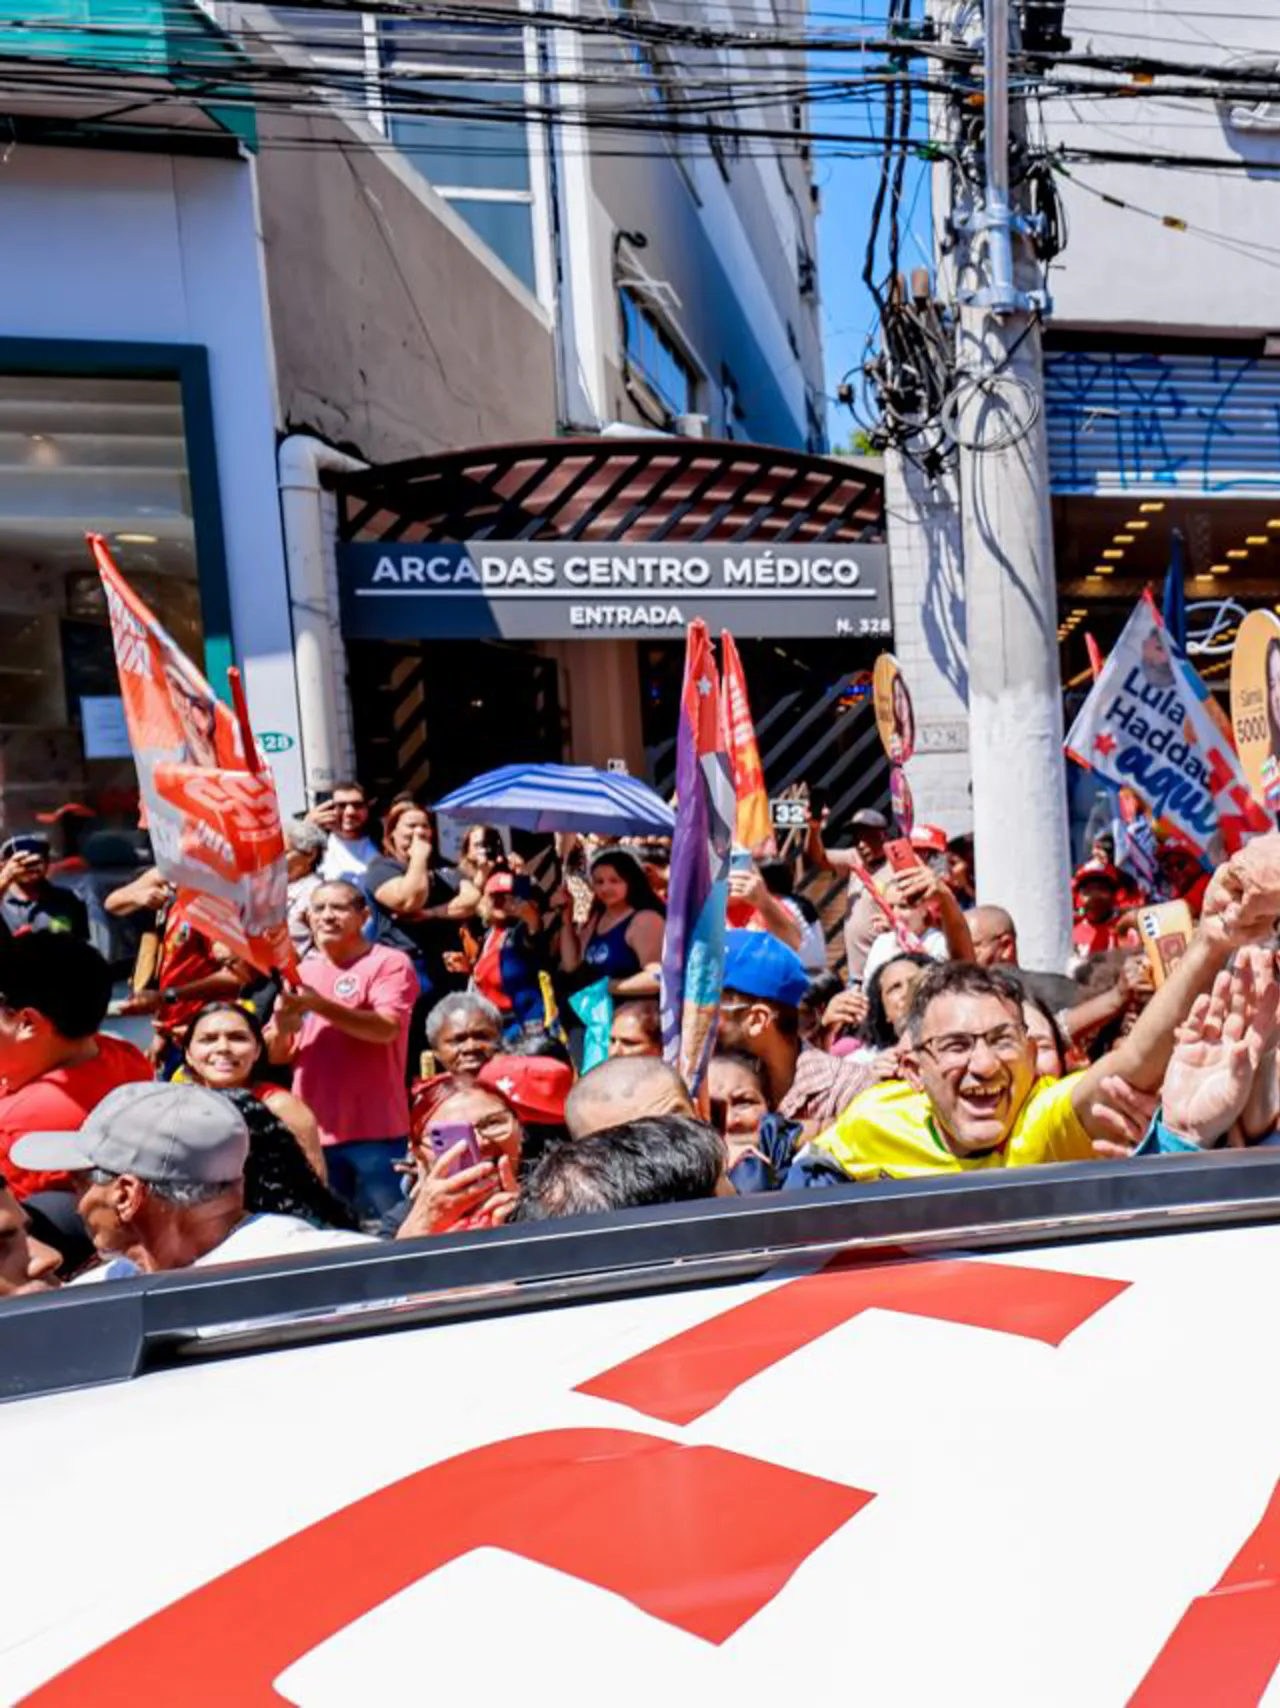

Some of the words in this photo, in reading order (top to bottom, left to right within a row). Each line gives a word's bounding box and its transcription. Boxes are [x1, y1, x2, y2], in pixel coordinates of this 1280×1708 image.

[372, 556, 554, 584] ARCADAS
[563, 557, 710, 585] CENTRO
[723, 550, 860, 585] MÉDICO
[570, 606, 684, 625] ENTRADA
[836, 617, 853, 634] N.
[859, 618, 891, 633] 328
[1121, 665, 1187, 727] Lula
